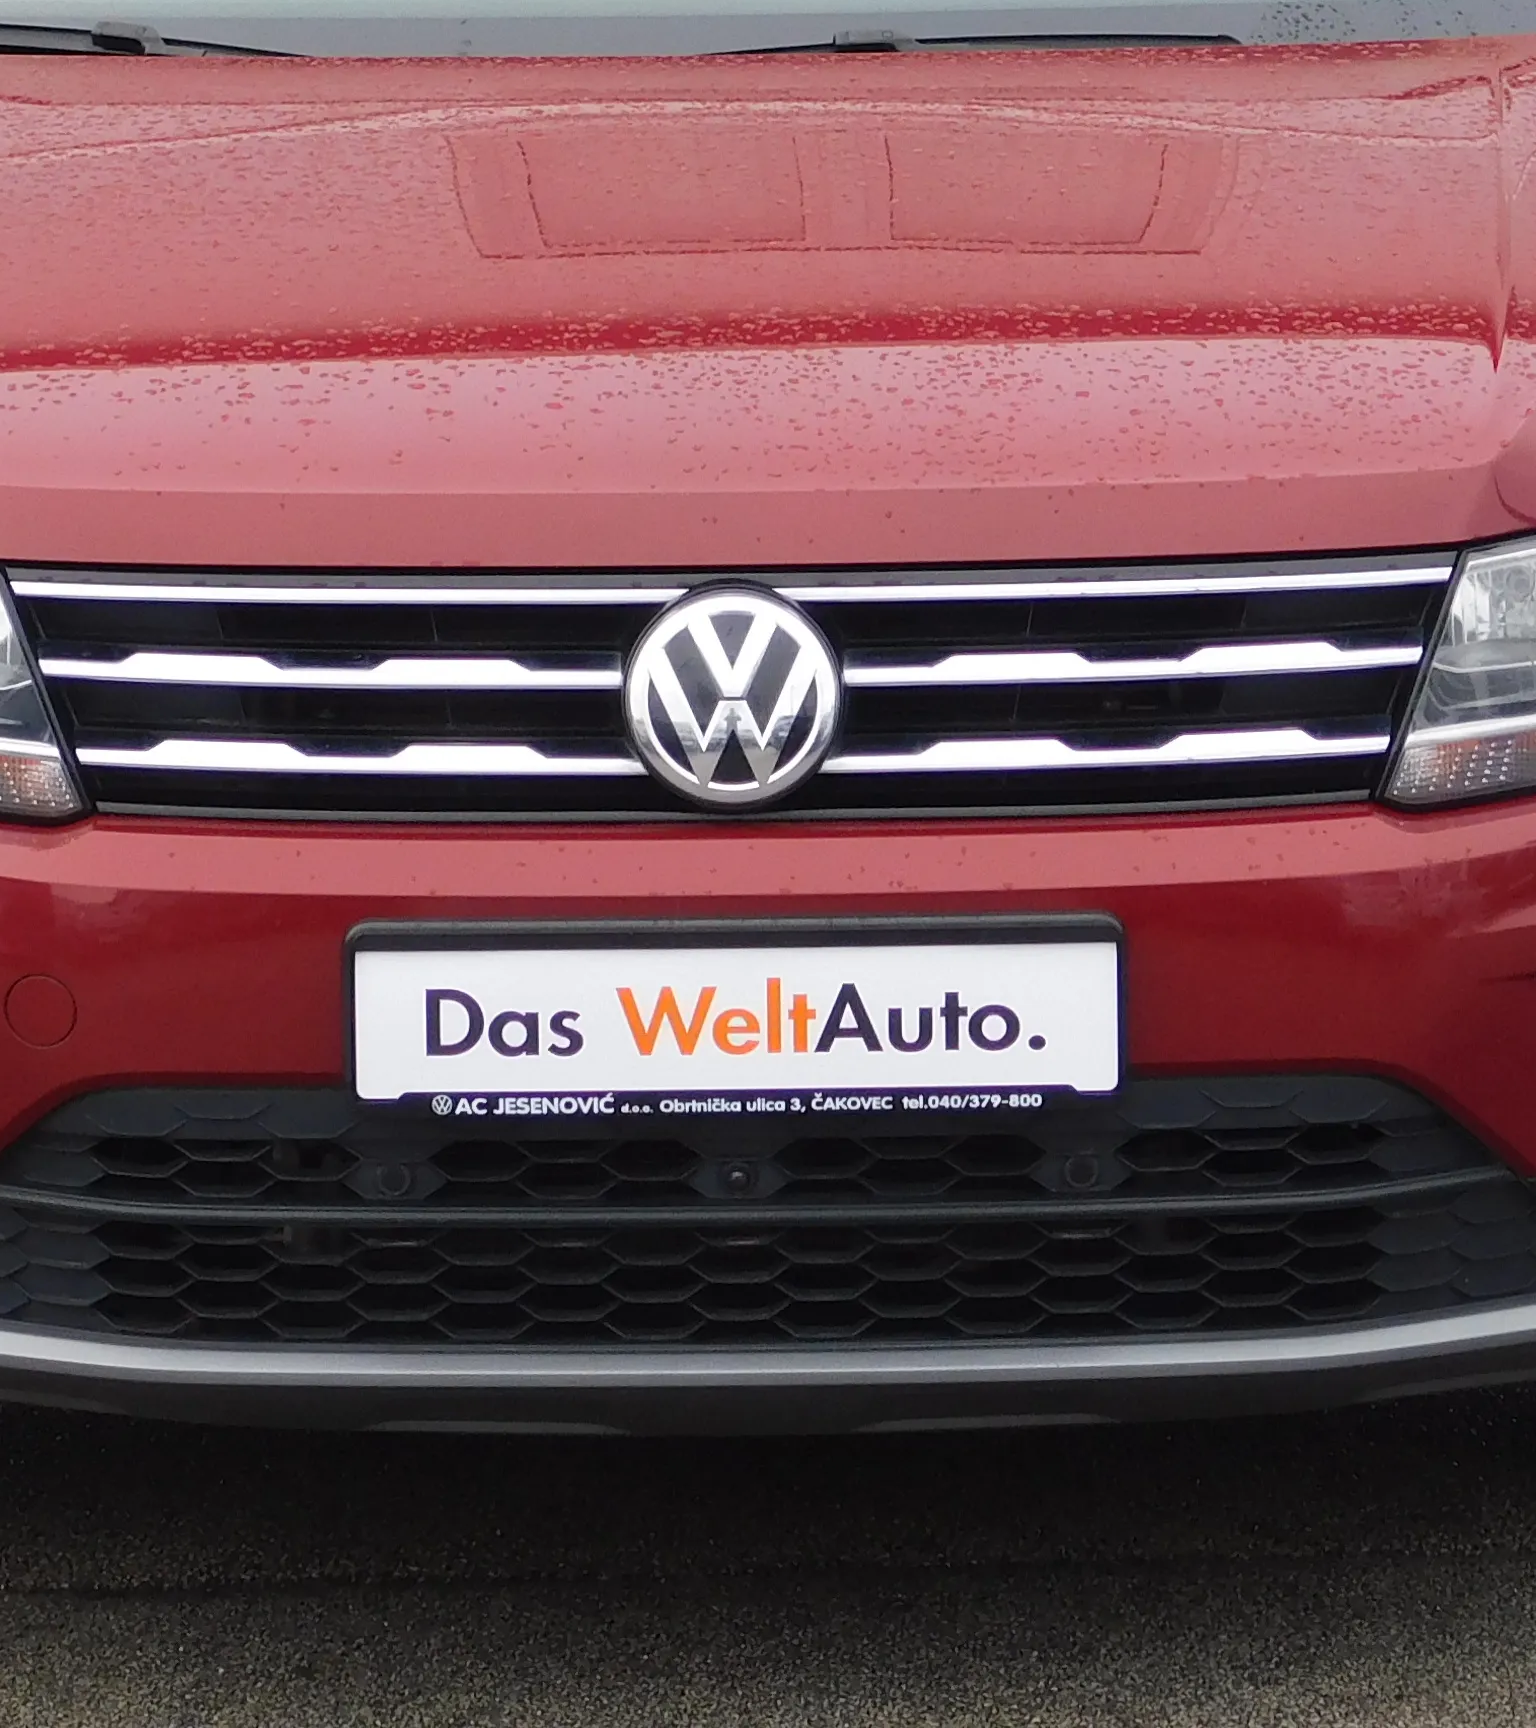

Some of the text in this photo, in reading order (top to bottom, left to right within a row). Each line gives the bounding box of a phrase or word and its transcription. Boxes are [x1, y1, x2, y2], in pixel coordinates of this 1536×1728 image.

[424, 977, 1047, 1057] Das WeltAuto.
[454, 1097, 488, 1115] AC
[492, 1092, 615, 1115] JESENOVIĆ
[659, 1097, 742, 1113] Obrtnička
[746, 1097, 786, 1112] ulica
[789, 1097, 806, 1113] 3,
[810, 1092, 894, 1111] ČAKOVEC
[901, 1093, 1043, 1110] tel.040/379-800
